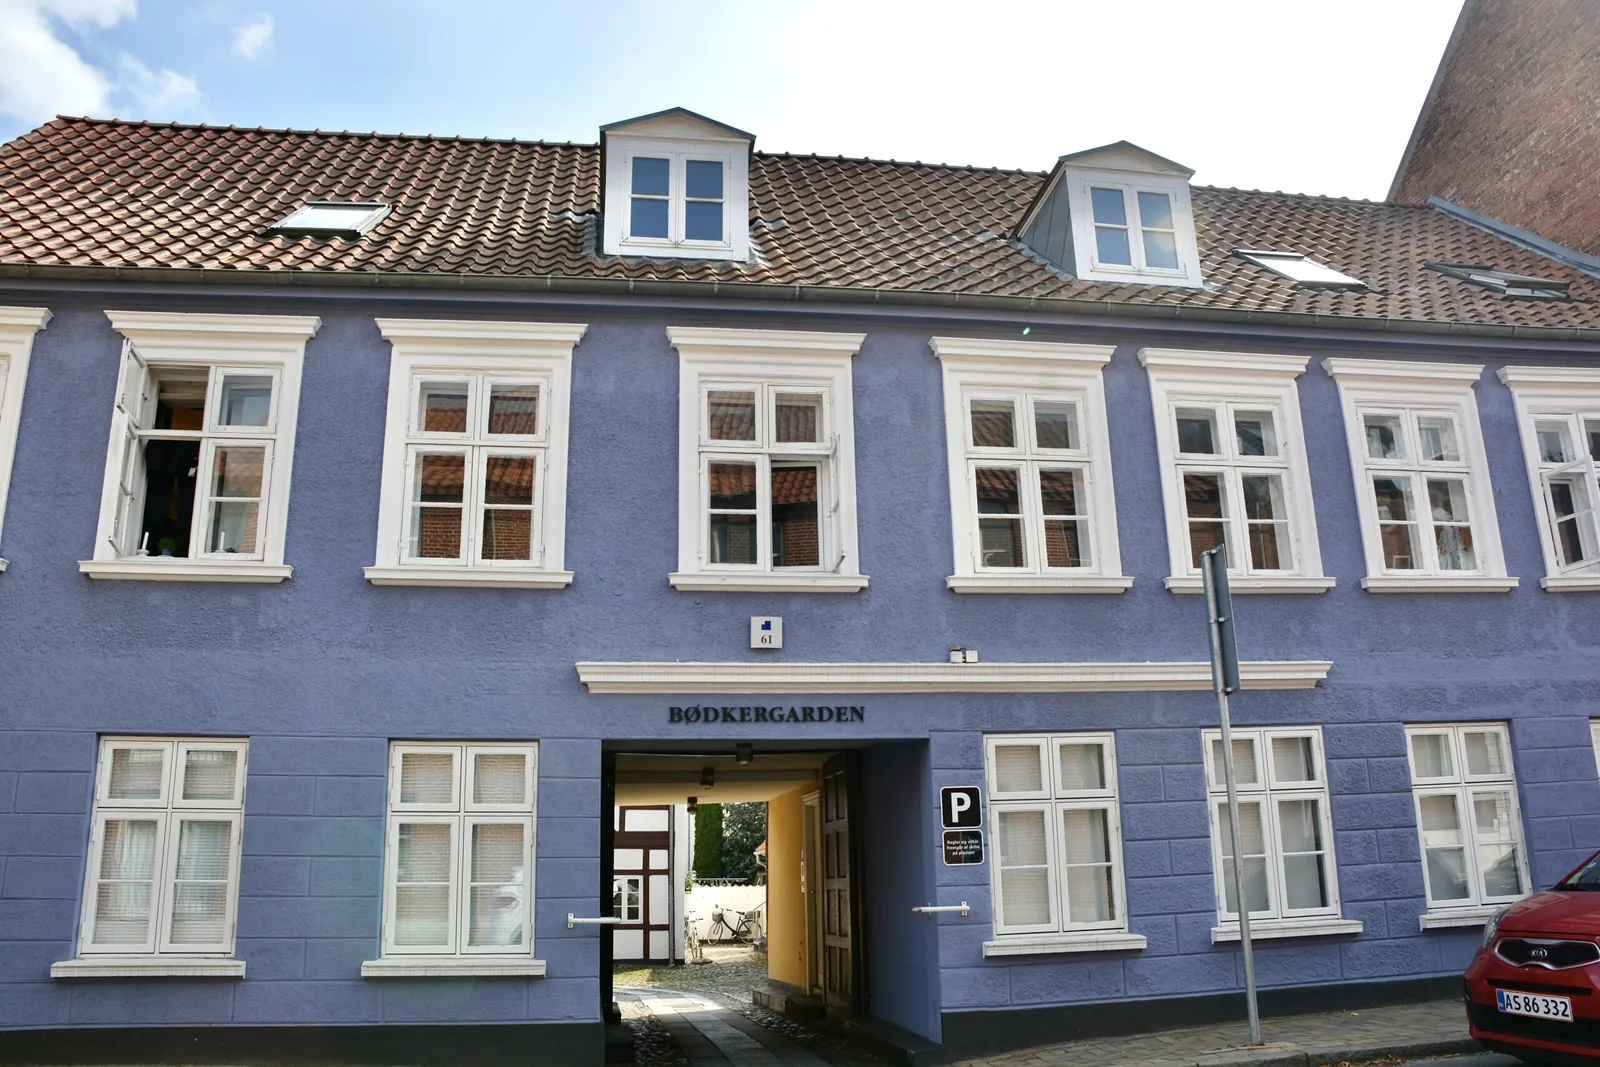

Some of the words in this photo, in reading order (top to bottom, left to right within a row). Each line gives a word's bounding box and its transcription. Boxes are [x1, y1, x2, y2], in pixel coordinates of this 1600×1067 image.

[760, 634, 772, 645] 61
[668, 704, 865, 725] BØDKERGARDEN
[950, 792, 971, 823] P
[1531, 949, 1544, 957] KIA
[1506, 994, 1522, 1011] AS
[1523, 996, 1540, 1013] 86
[1542, 999, 1569, 1017] 332
